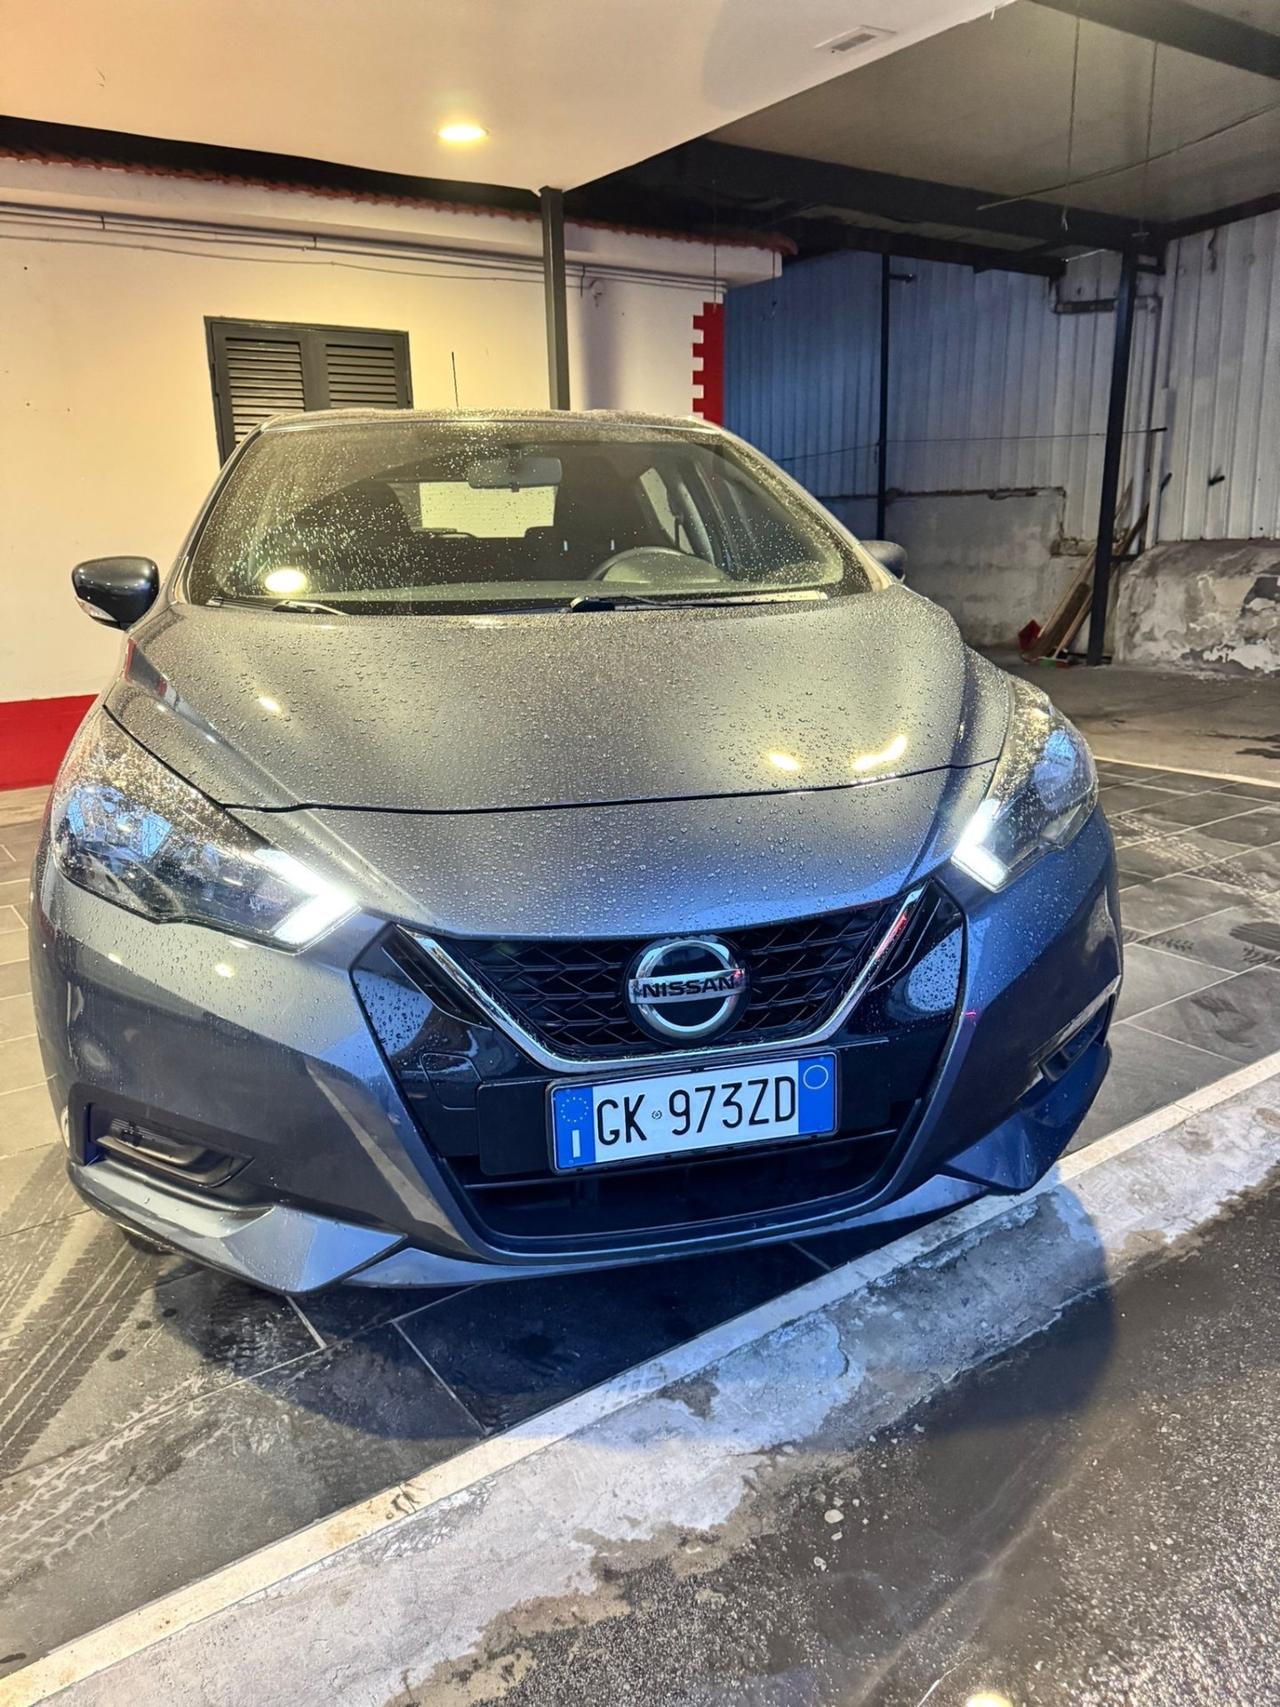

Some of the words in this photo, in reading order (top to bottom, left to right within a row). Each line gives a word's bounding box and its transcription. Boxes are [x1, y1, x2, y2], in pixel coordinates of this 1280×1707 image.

[642, 978, 736, 998] NISSAN
[596, 1094, 648, 1146] GK
[668, 1075, 797, 1136] 973ZD
[571, 1129, 581, 1158] I
